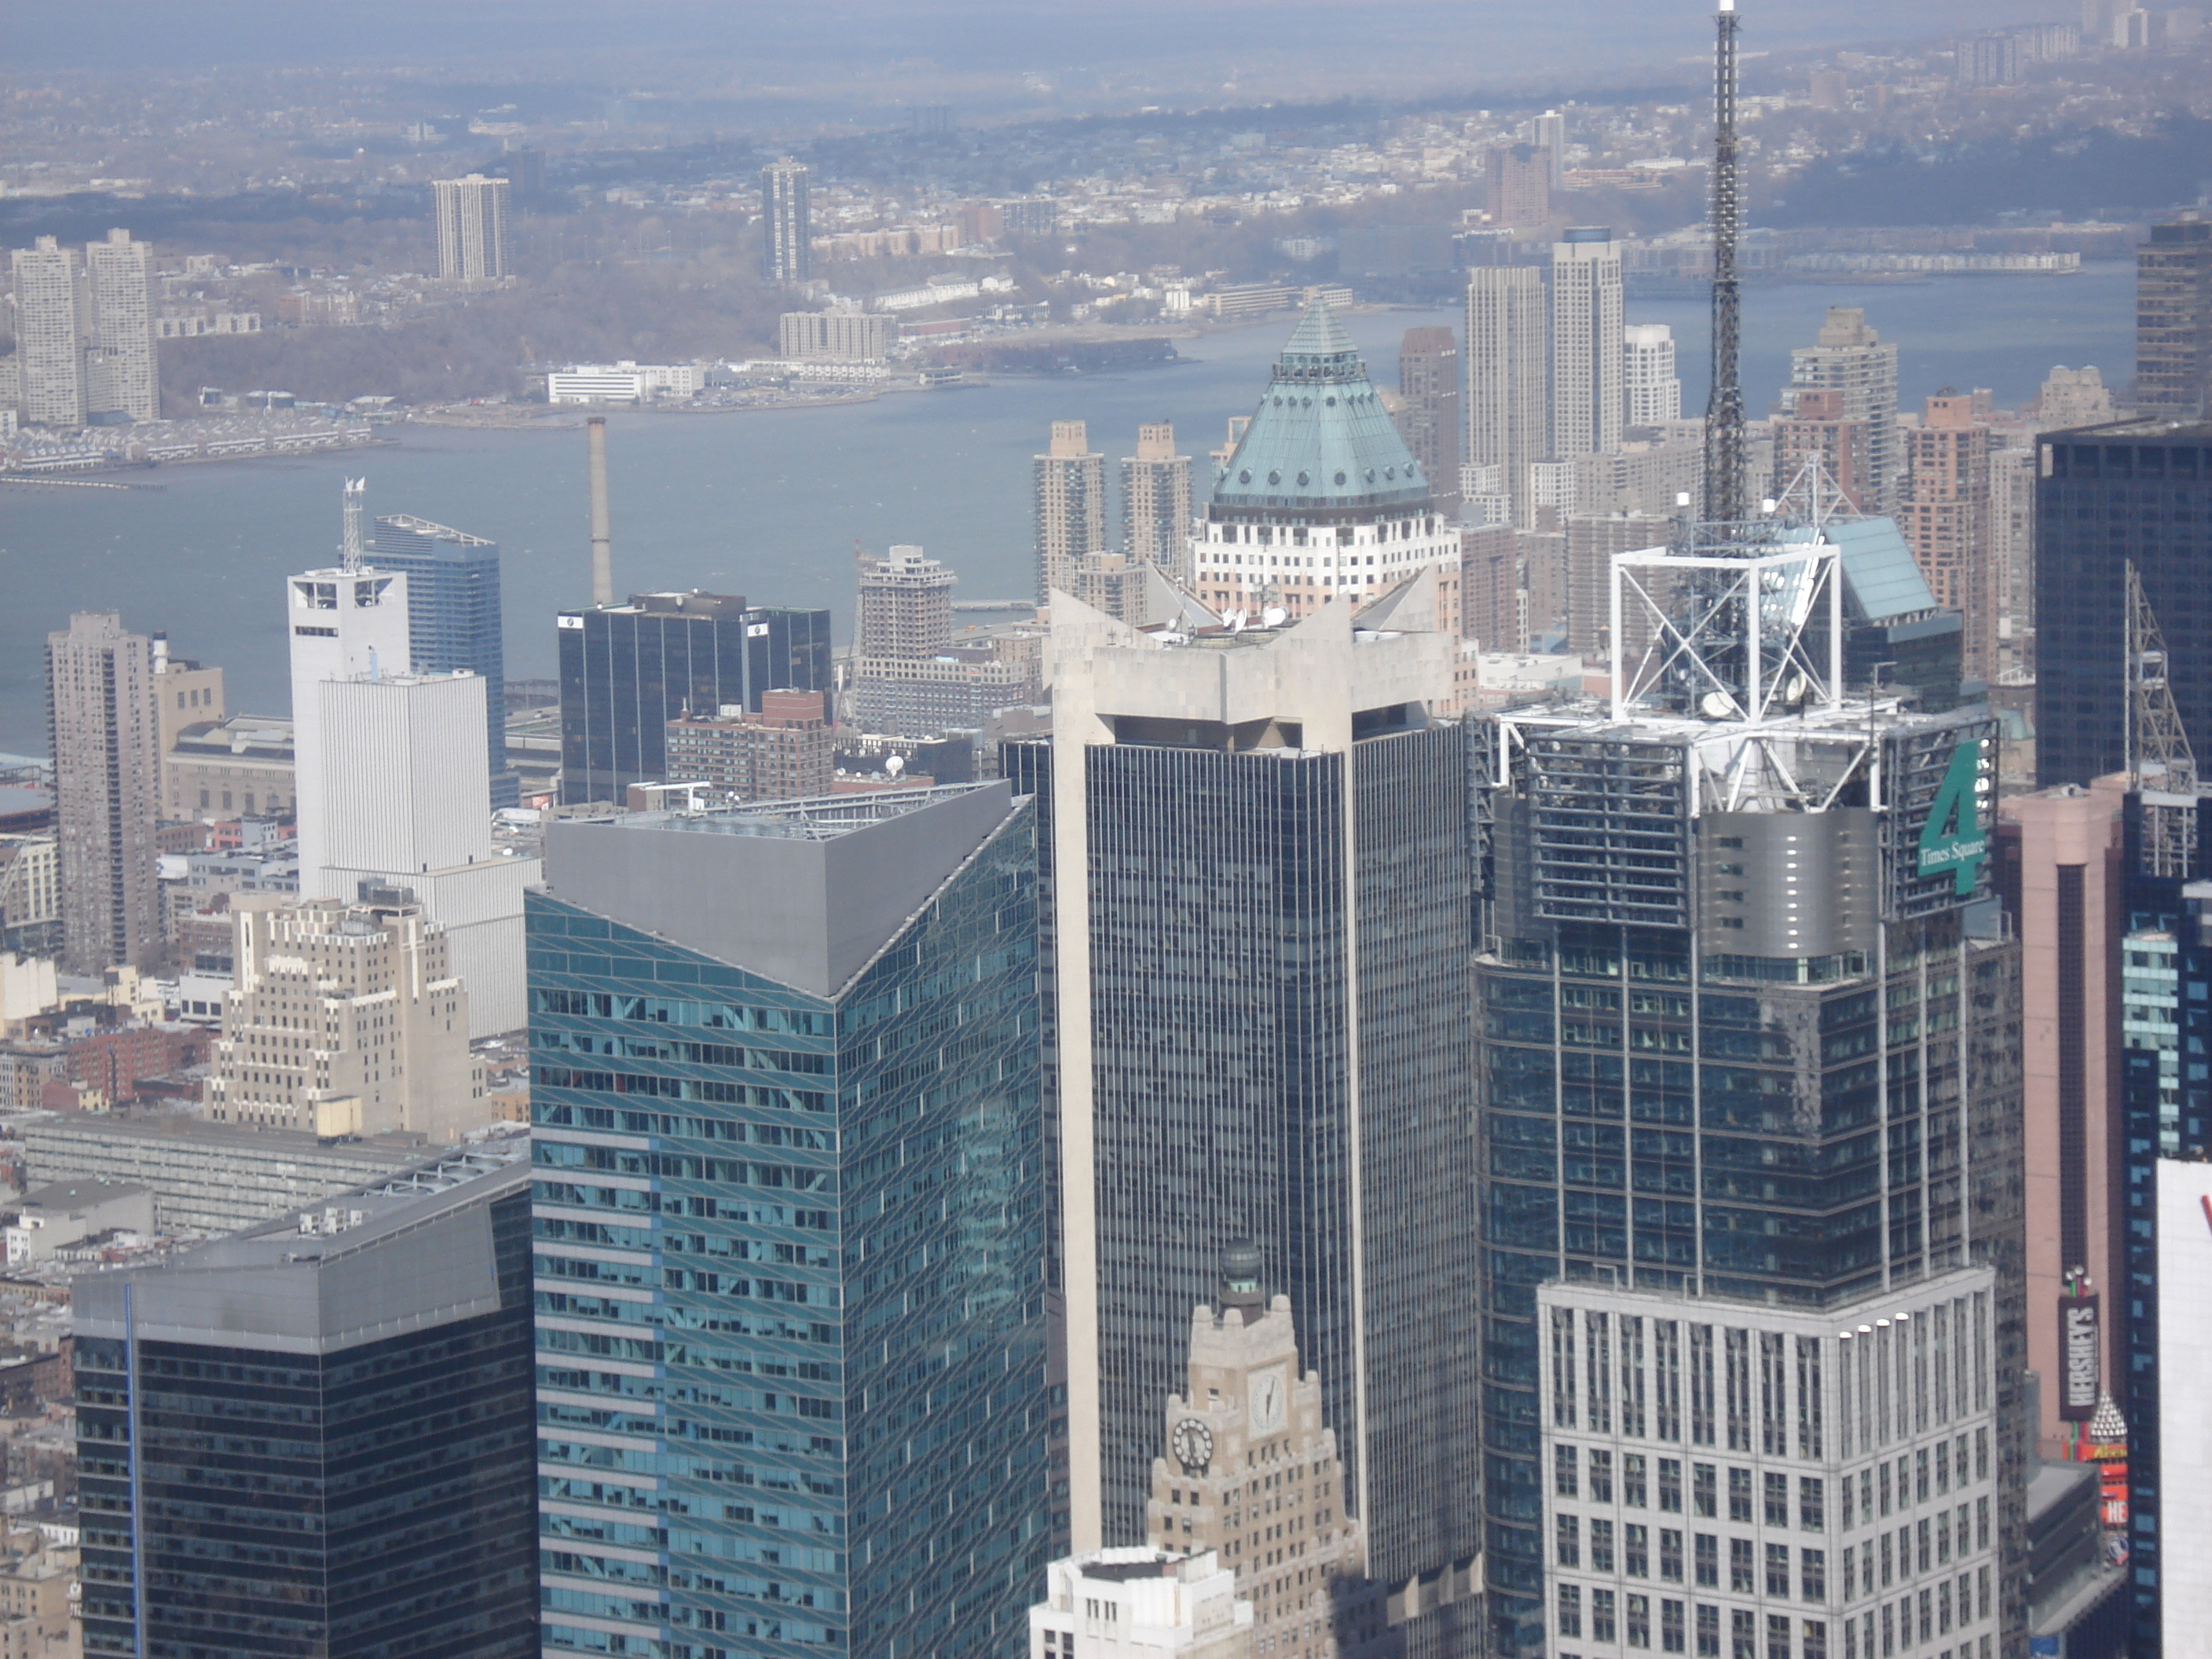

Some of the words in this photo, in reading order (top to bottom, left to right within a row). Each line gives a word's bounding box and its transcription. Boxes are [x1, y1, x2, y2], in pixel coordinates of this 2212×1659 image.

[1918, 740, 1985, 894] 4
[1920, 848, 1950, 866] Times
[1951, 840, 1985, 861] Square
[2067, 1307, 2095, 1406] HERSHEY'S
